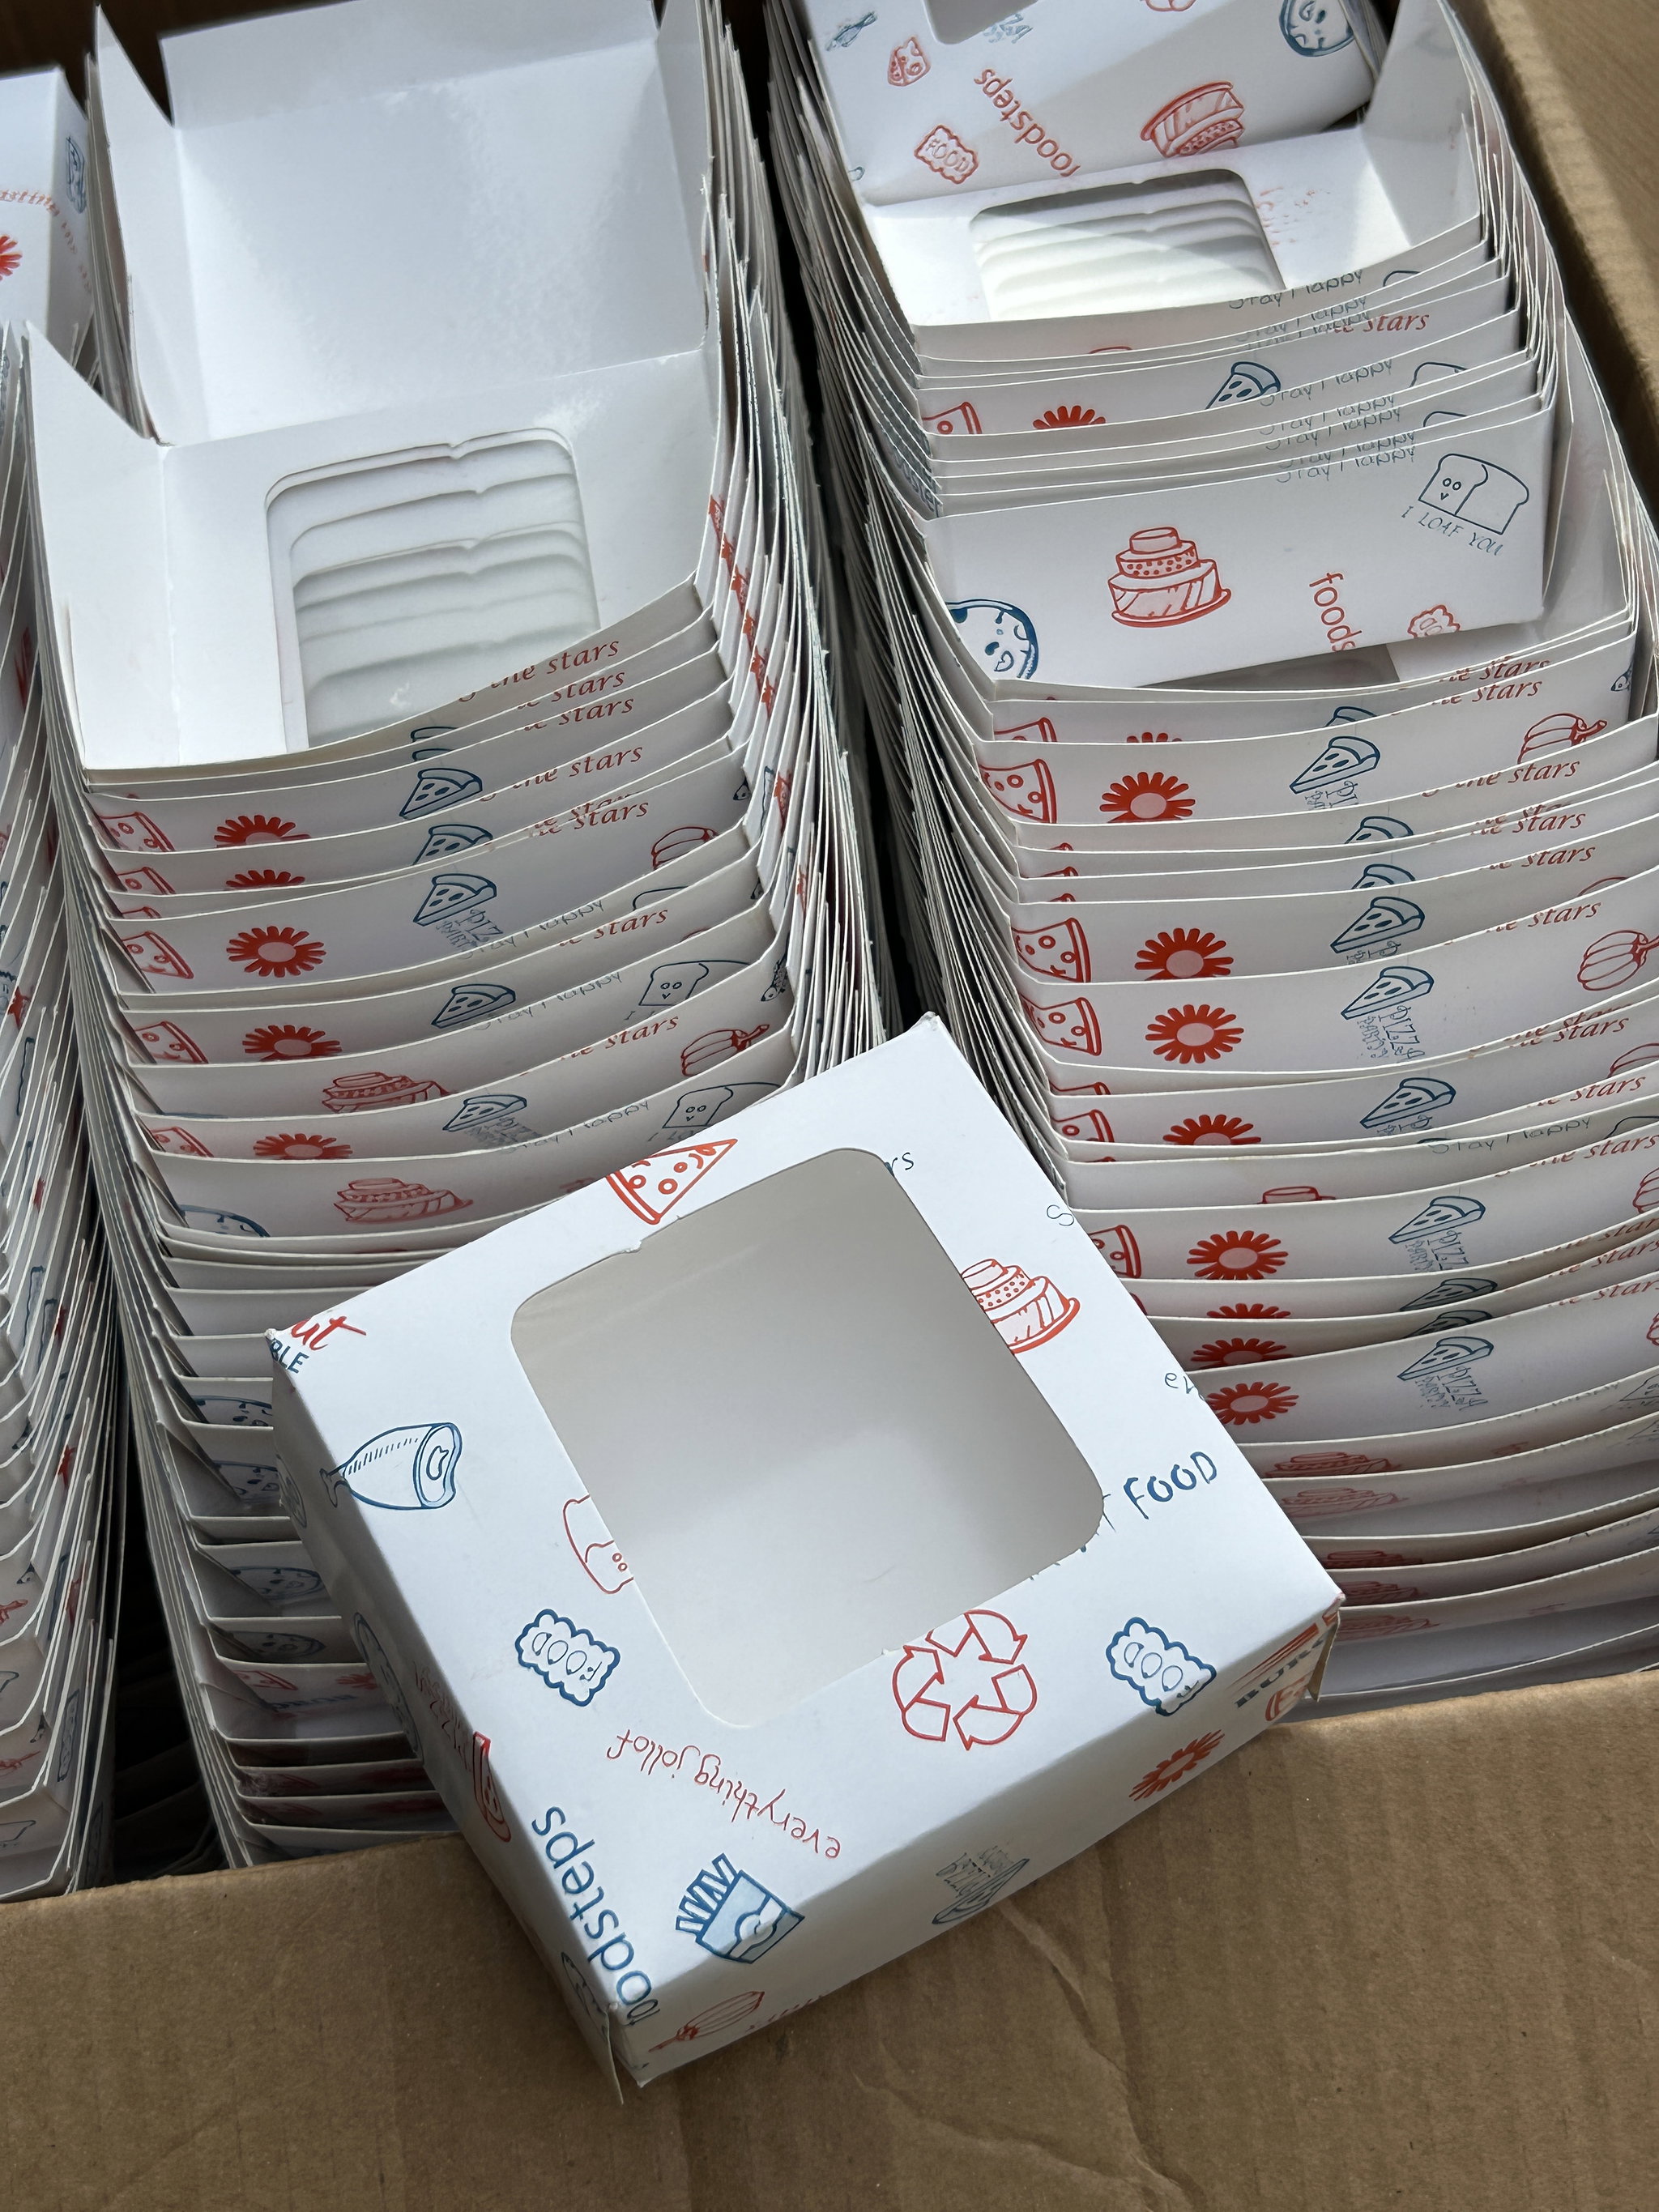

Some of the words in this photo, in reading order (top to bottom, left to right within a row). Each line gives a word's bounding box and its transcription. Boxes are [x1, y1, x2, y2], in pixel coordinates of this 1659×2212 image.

[1401, 505, 1414, 519] I
[1418, 511, 1465, 538] LOAF
[1469, 531, 1504, 557] YOU
[546, 641, 620, 675] stars
[551, 671, 625, 702] stars
[1471, 679, 1543, 702] stars
[559, 698, 634, 726] stars
[569, 746, 643, 778] stars
[1508, 758, 1580, 783] stars
[574, 802, 649, 830] stars
[1512, 810, 1586, 834] stars
[1520, 845, 1596, 867] stars
[593, 909, 668, 940] stars
[1531, 901, 1601, 927] stars
[604, 1015, 680, 1049] stars
[1378, 1005, 1426, 1061] PIZZA
[1553, 1016, 1630, 1043] stars
[1569, 1075, 1647, 1102] stars
[1584, 1136, 1659, 1159] stars
[1427, 1230, 1469, 1271] PIZZ
[291, 1316, 367, 1351] ut
[1124, 1451, 1218, 1520] FOOD
[531, 1631, 603, 1690] FOOD
[1124, 1642, 1200, 1699] FOOD
[606, 1728, 701, 1779] jollof
[694, 1754, 842, 1860] everything
